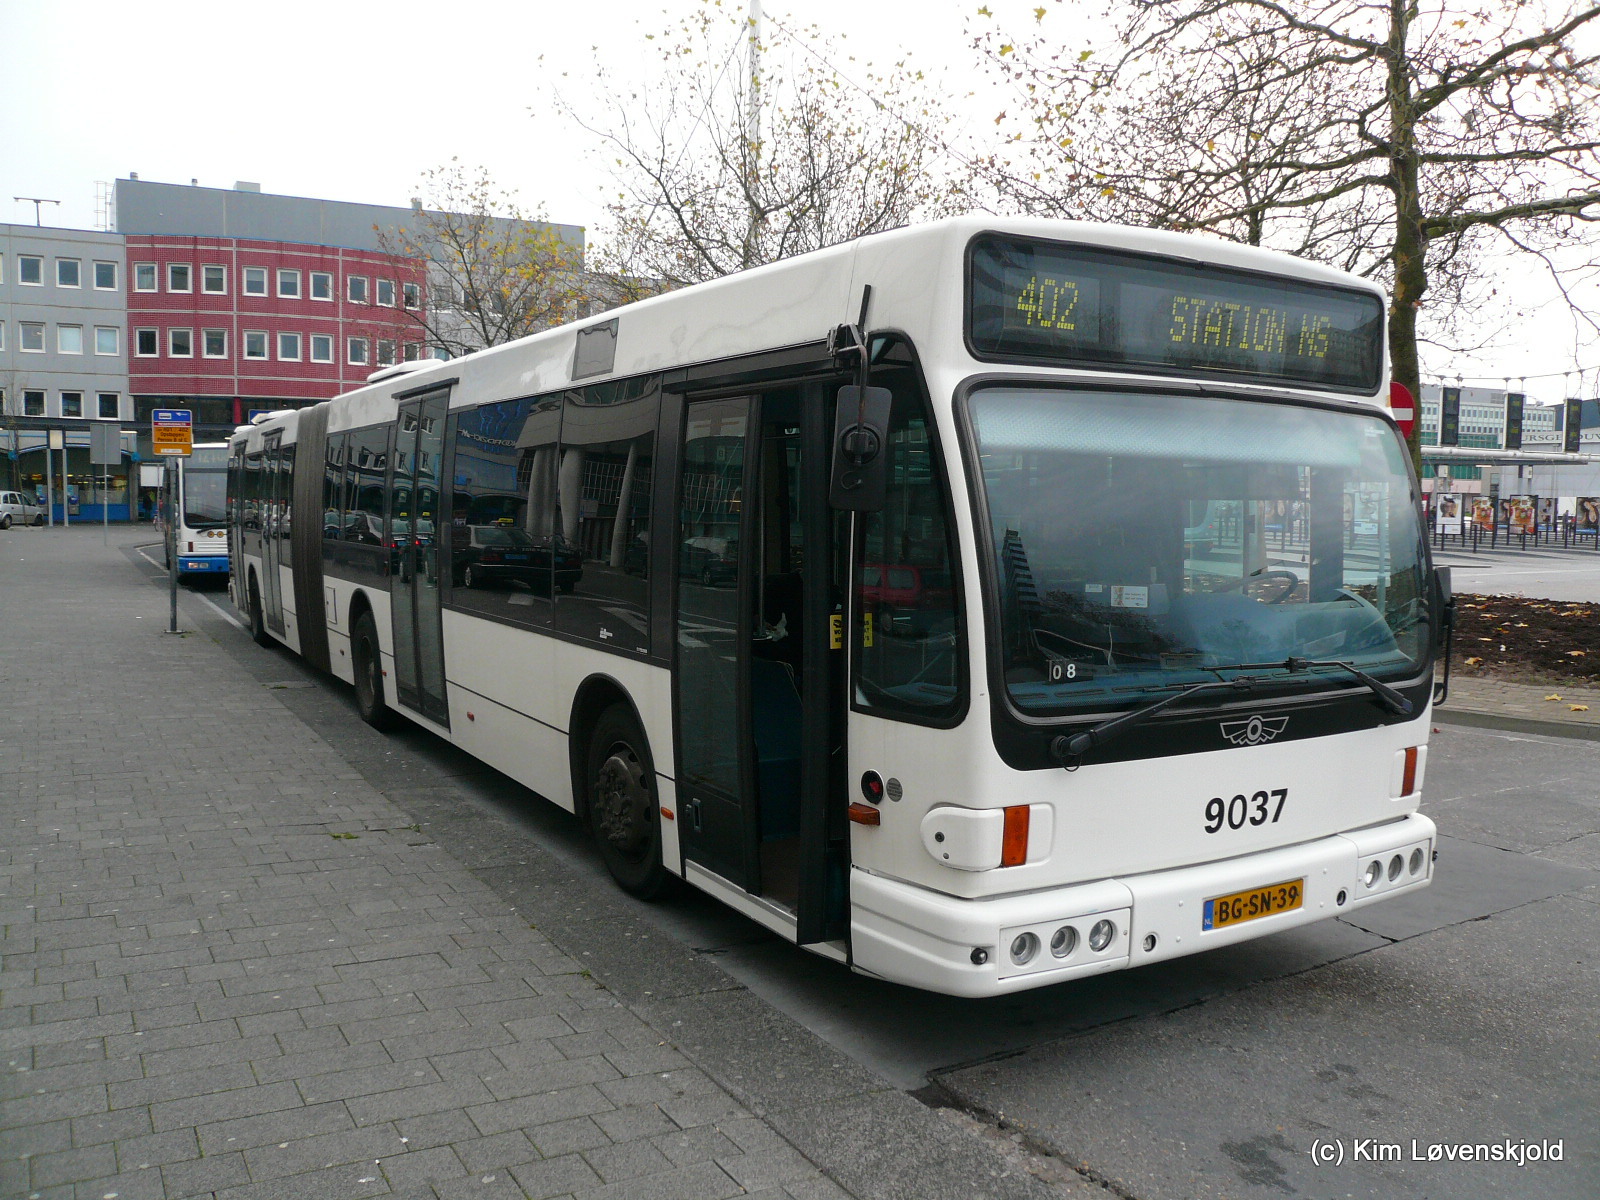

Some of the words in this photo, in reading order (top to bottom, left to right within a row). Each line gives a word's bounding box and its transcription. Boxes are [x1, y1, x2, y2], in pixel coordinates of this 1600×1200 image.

[1016, 276, 1079, 331] 402
[1168, 295, 1287, 354] STATION
[1297, 313, 1331, 358] NS
[1204, 787, 1289, 834] 9037
[1218, 884, 1300, 924] BG-SN-39
